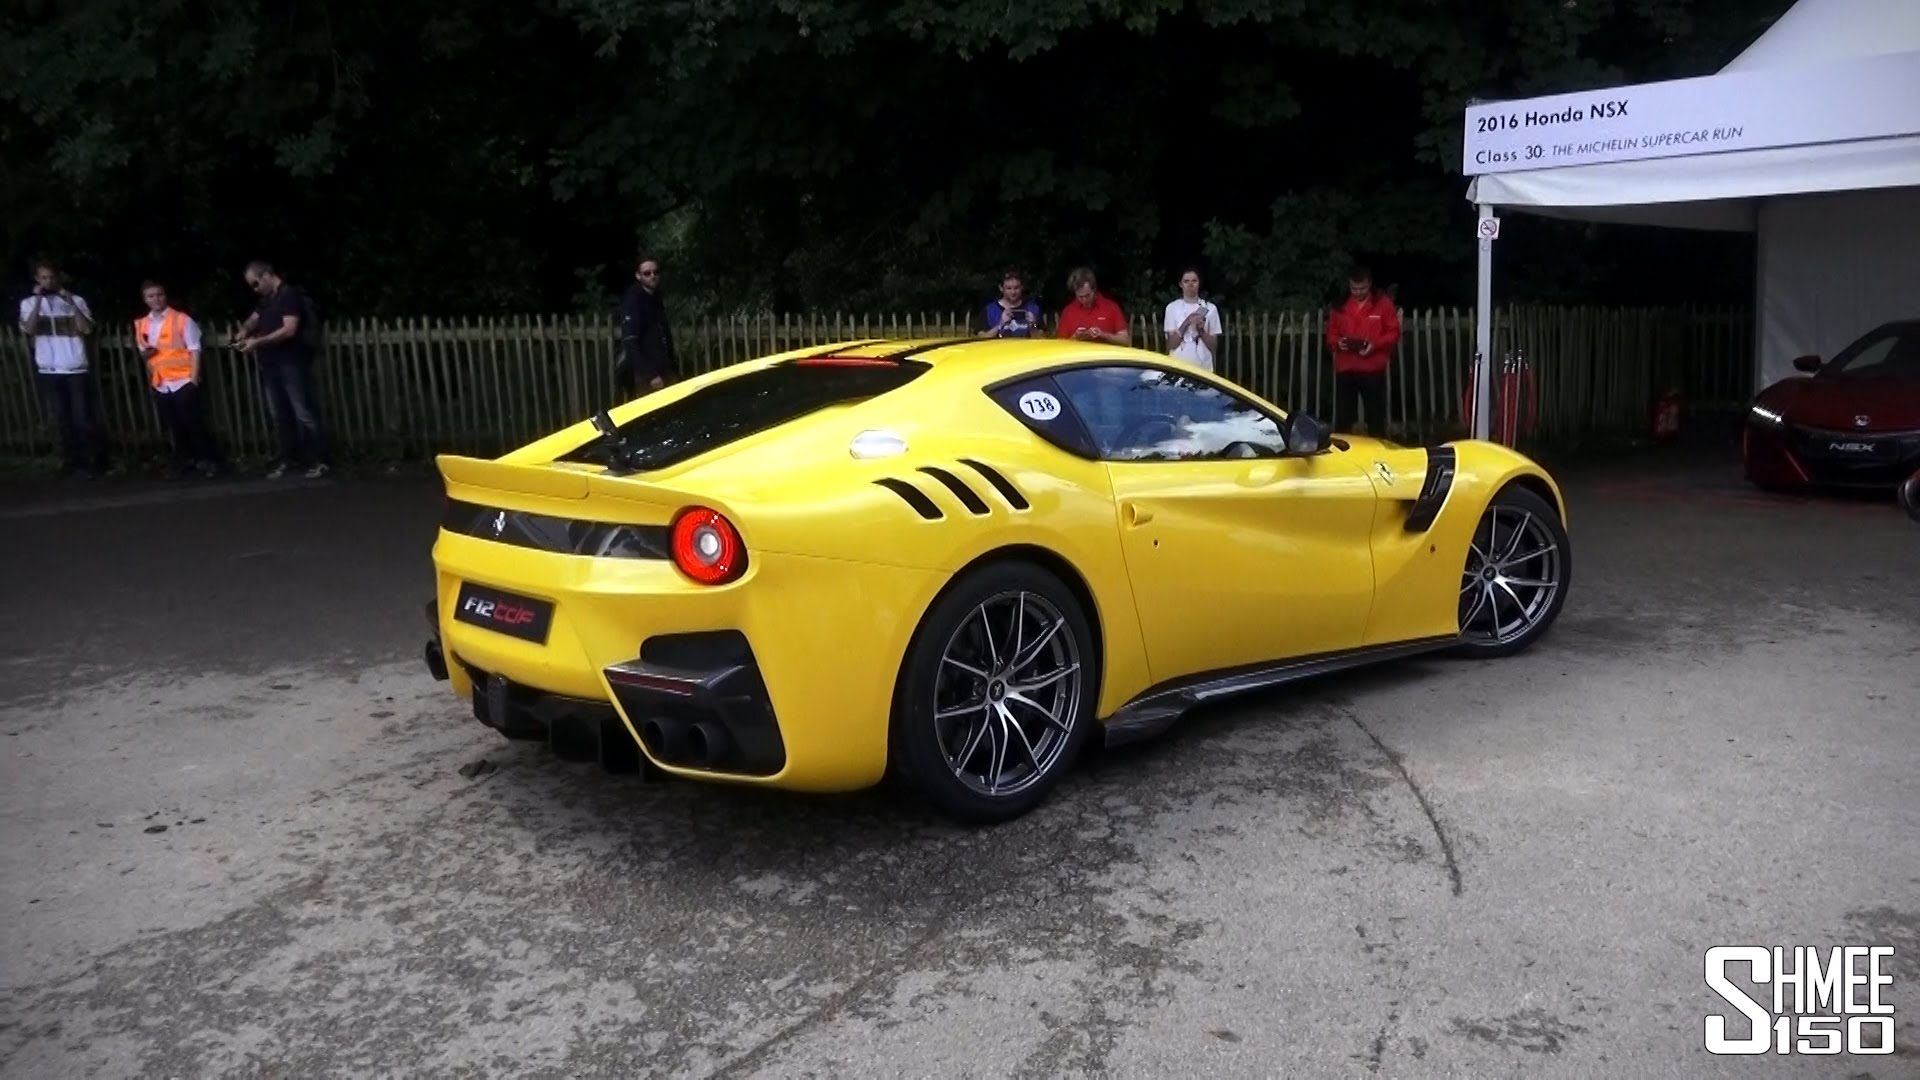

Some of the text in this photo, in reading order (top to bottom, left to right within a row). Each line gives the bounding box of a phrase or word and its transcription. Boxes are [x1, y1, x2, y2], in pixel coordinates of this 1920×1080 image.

[1477, 99, 1629, 133] 2016 Honda NSX
[1476, 149, 1517, 164] Class
[1552, 142, 1573, 156] THE
[1577, 137, 1638, 154] MICHELIN
[1642, 129, 1708, 148] SUPERCAR
[1712, 126, 1743, 139] RUN
[1025, 397, 1054, 413] 738
[1829, 443, 1875, 452] NSX
